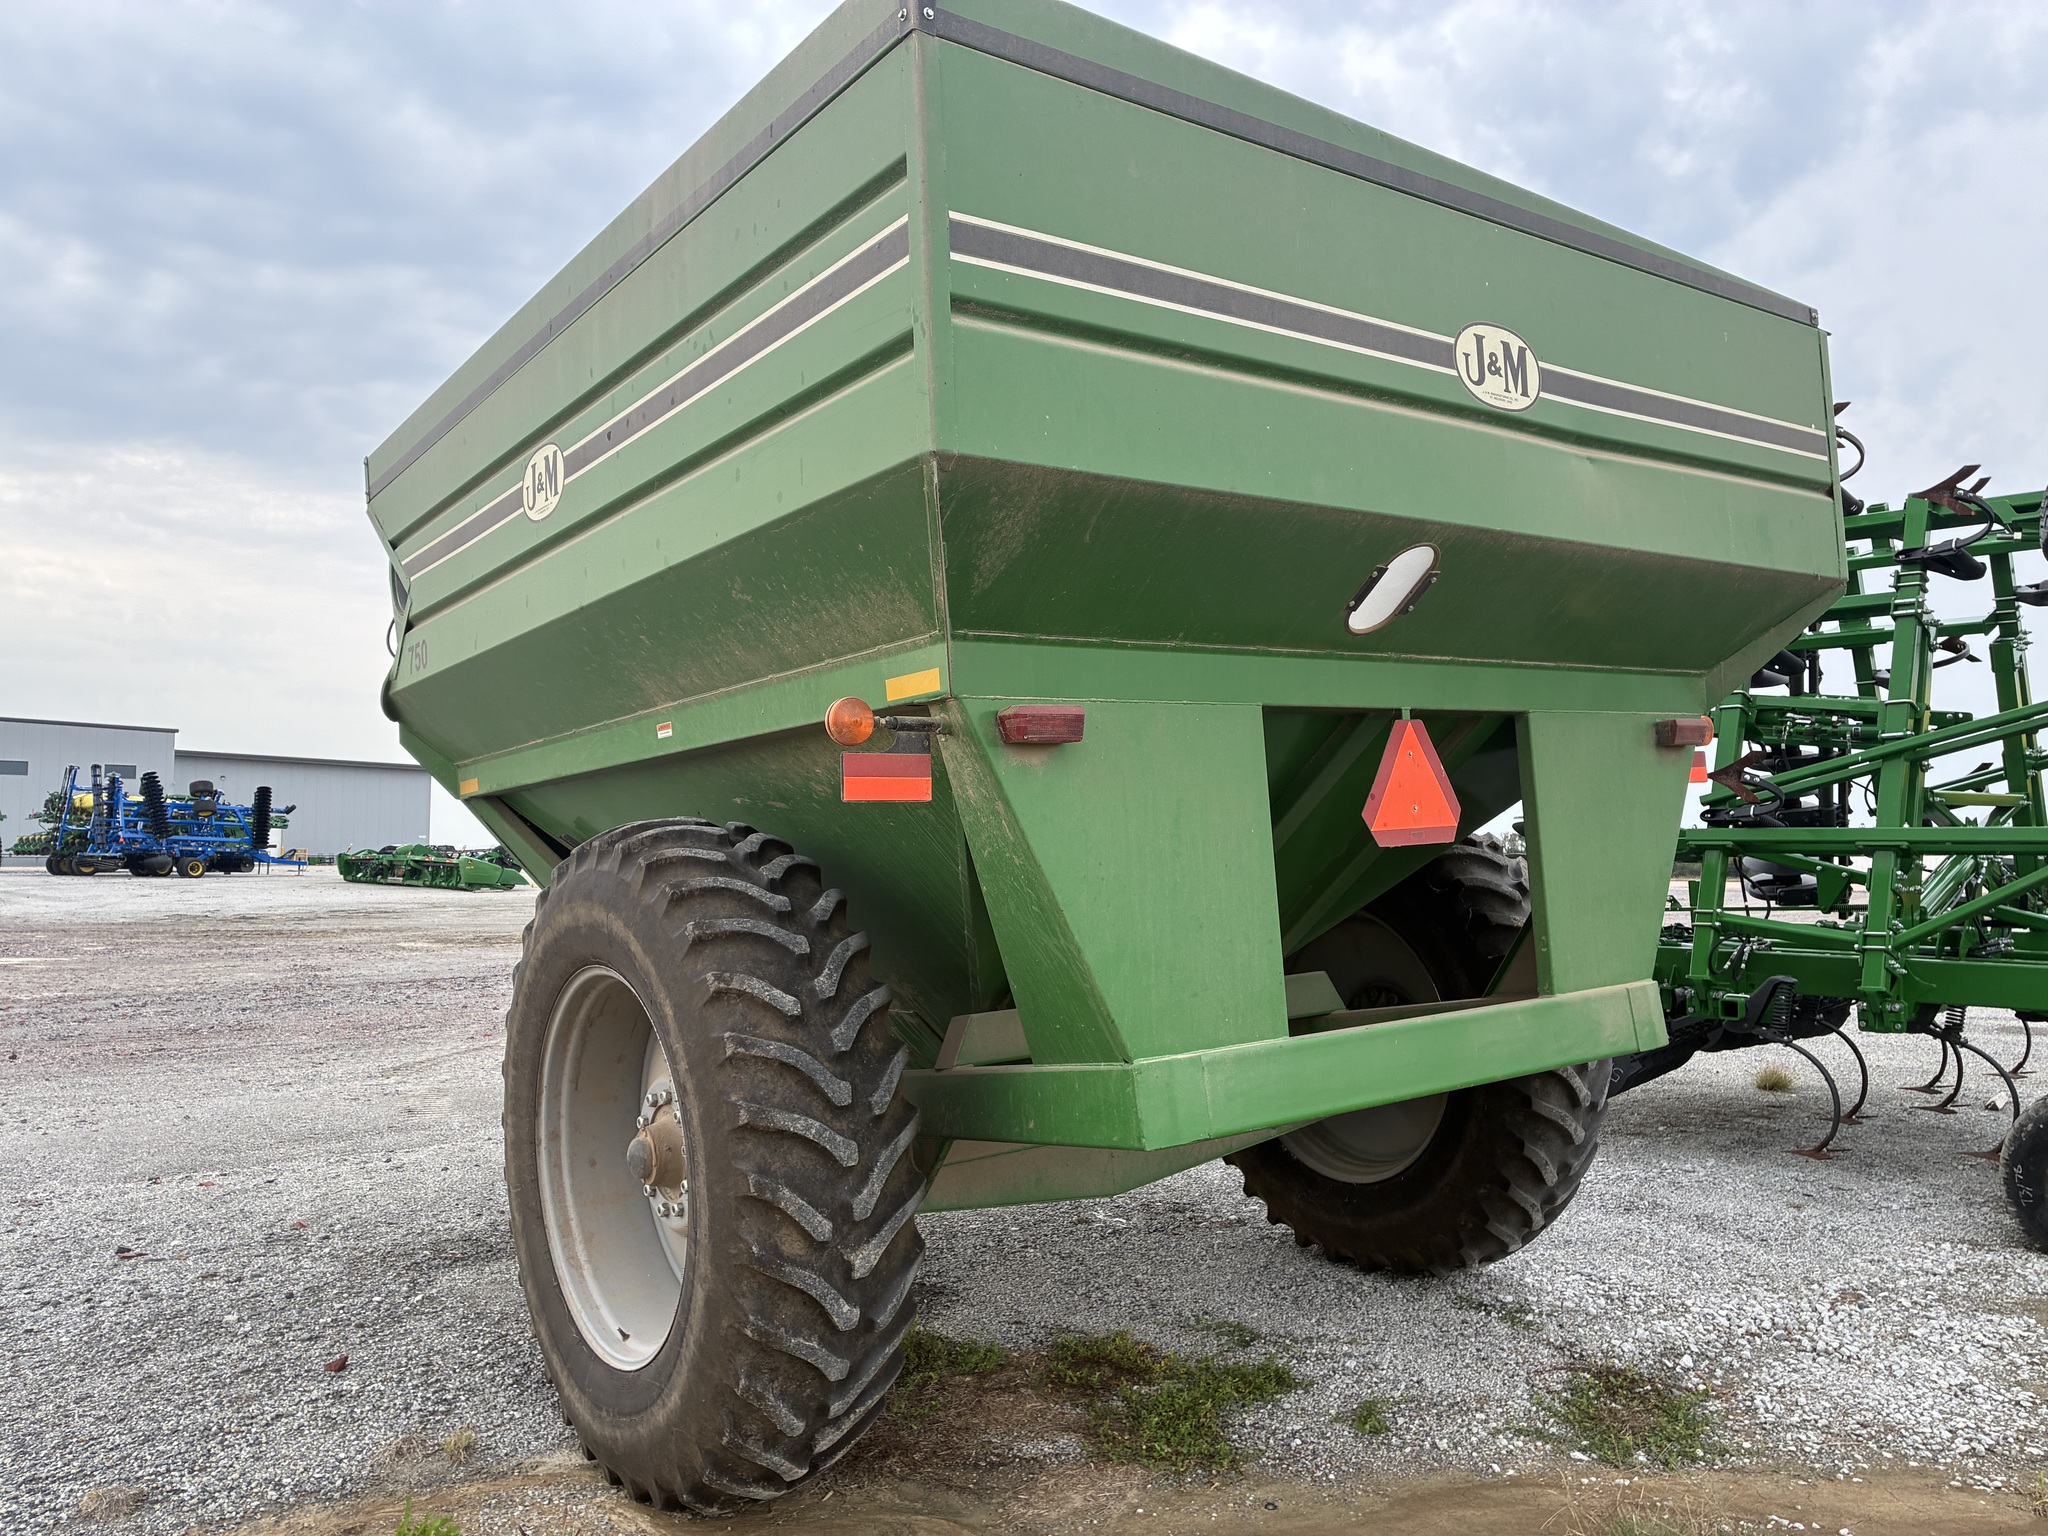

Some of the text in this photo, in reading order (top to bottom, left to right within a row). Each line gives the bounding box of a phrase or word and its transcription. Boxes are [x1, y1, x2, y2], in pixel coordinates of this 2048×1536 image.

[1462, 332, 1531, 399] J&M
[525, 448, 559, 512] J&M
[408, 639, 428, 675] 750
